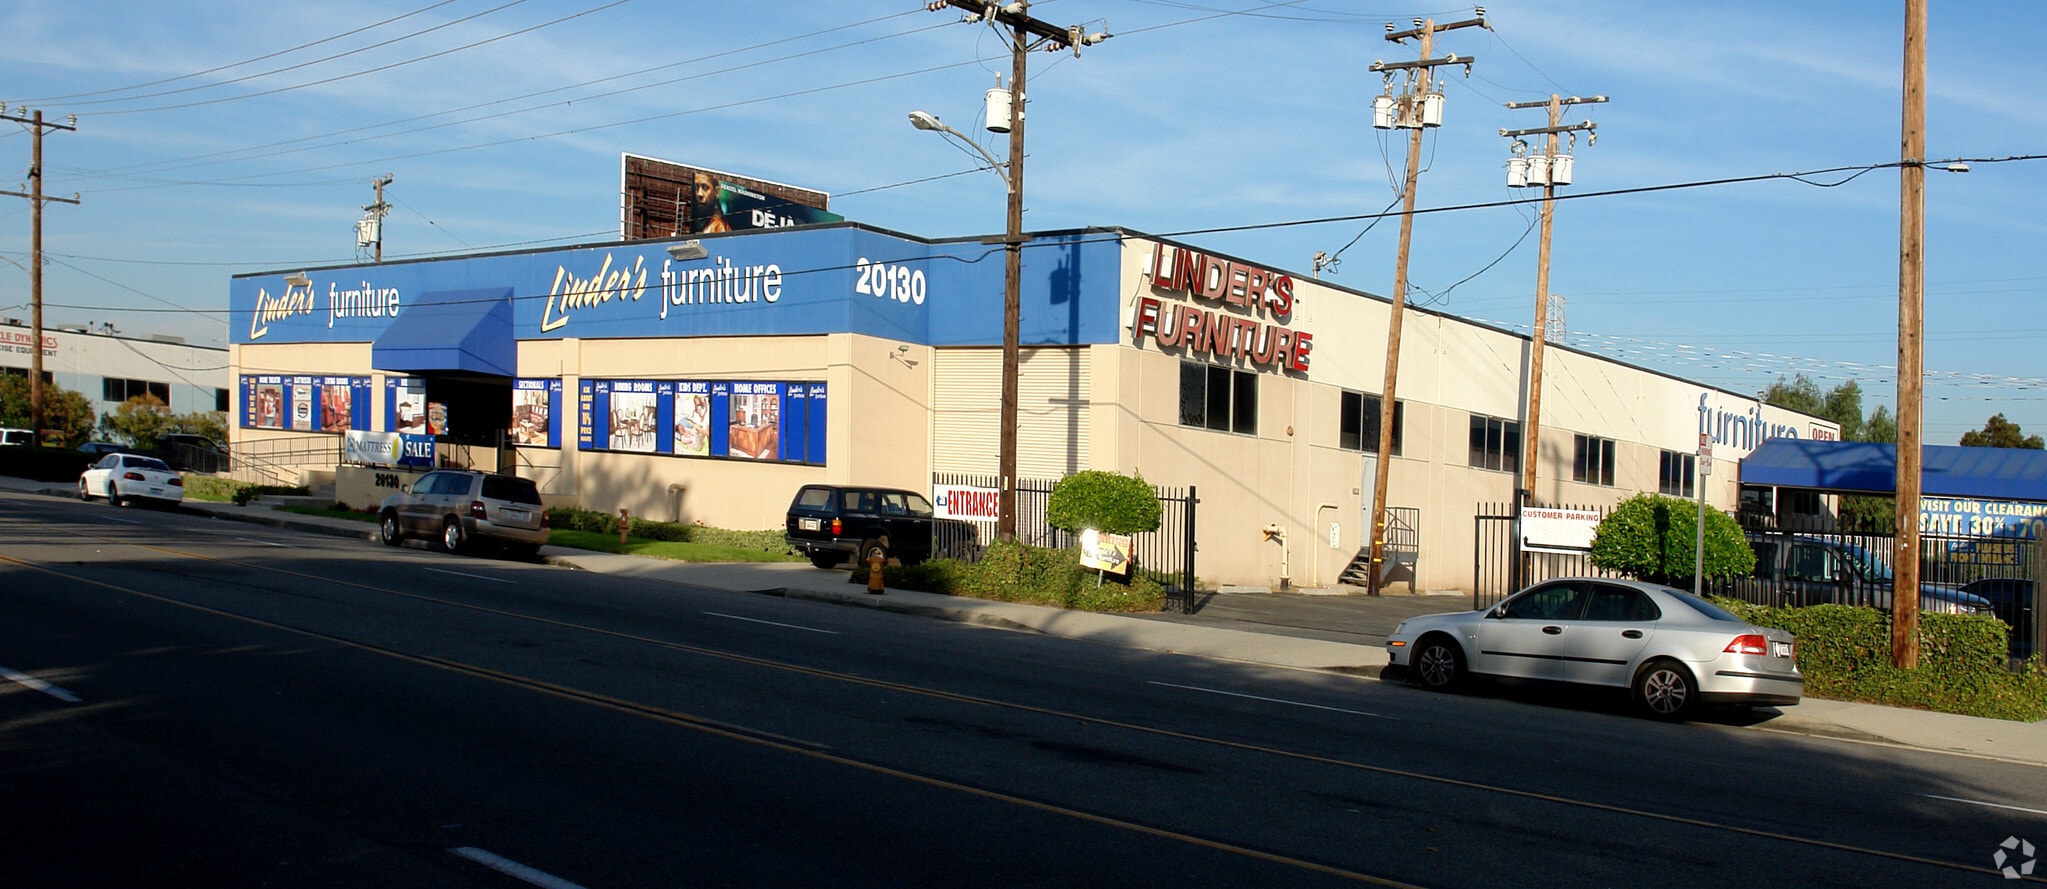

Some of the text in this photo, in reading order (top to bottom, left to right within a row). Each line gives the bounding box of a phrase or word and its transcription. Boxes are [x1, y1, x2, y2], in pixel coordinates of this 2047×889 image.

[856, 257, 927, 305] 20130
[1151, 243, 1294, 316] LINDER'S
[541, 252, 783, 333] Linder's furniture
[250, 280, 400, 340] Linder's furniture
[15, 333, 57, 347] DYNICS
[1132, 296, 1313, 372] FURNITURE
[16, 346, 57, 356] EQUIENT
[678, 382, 692, 392] KIDS
[733, 383, 777, 395] HOME OFFICES
[355, 440, 432, 458] MATTRESS SALE
[374, 472, 400, 489] 20130
[947, 489, 999, 518] ENTRANCE
[1919, 499, 1951, 512] VISIT
[1953, 501, 1981, 514] OUR
[1522, 510, 1599, 522] CUSTOMER PARKING
[1919, 512, 1963, 534] SAVE
[1970, 515, 2005, 535] 30%
